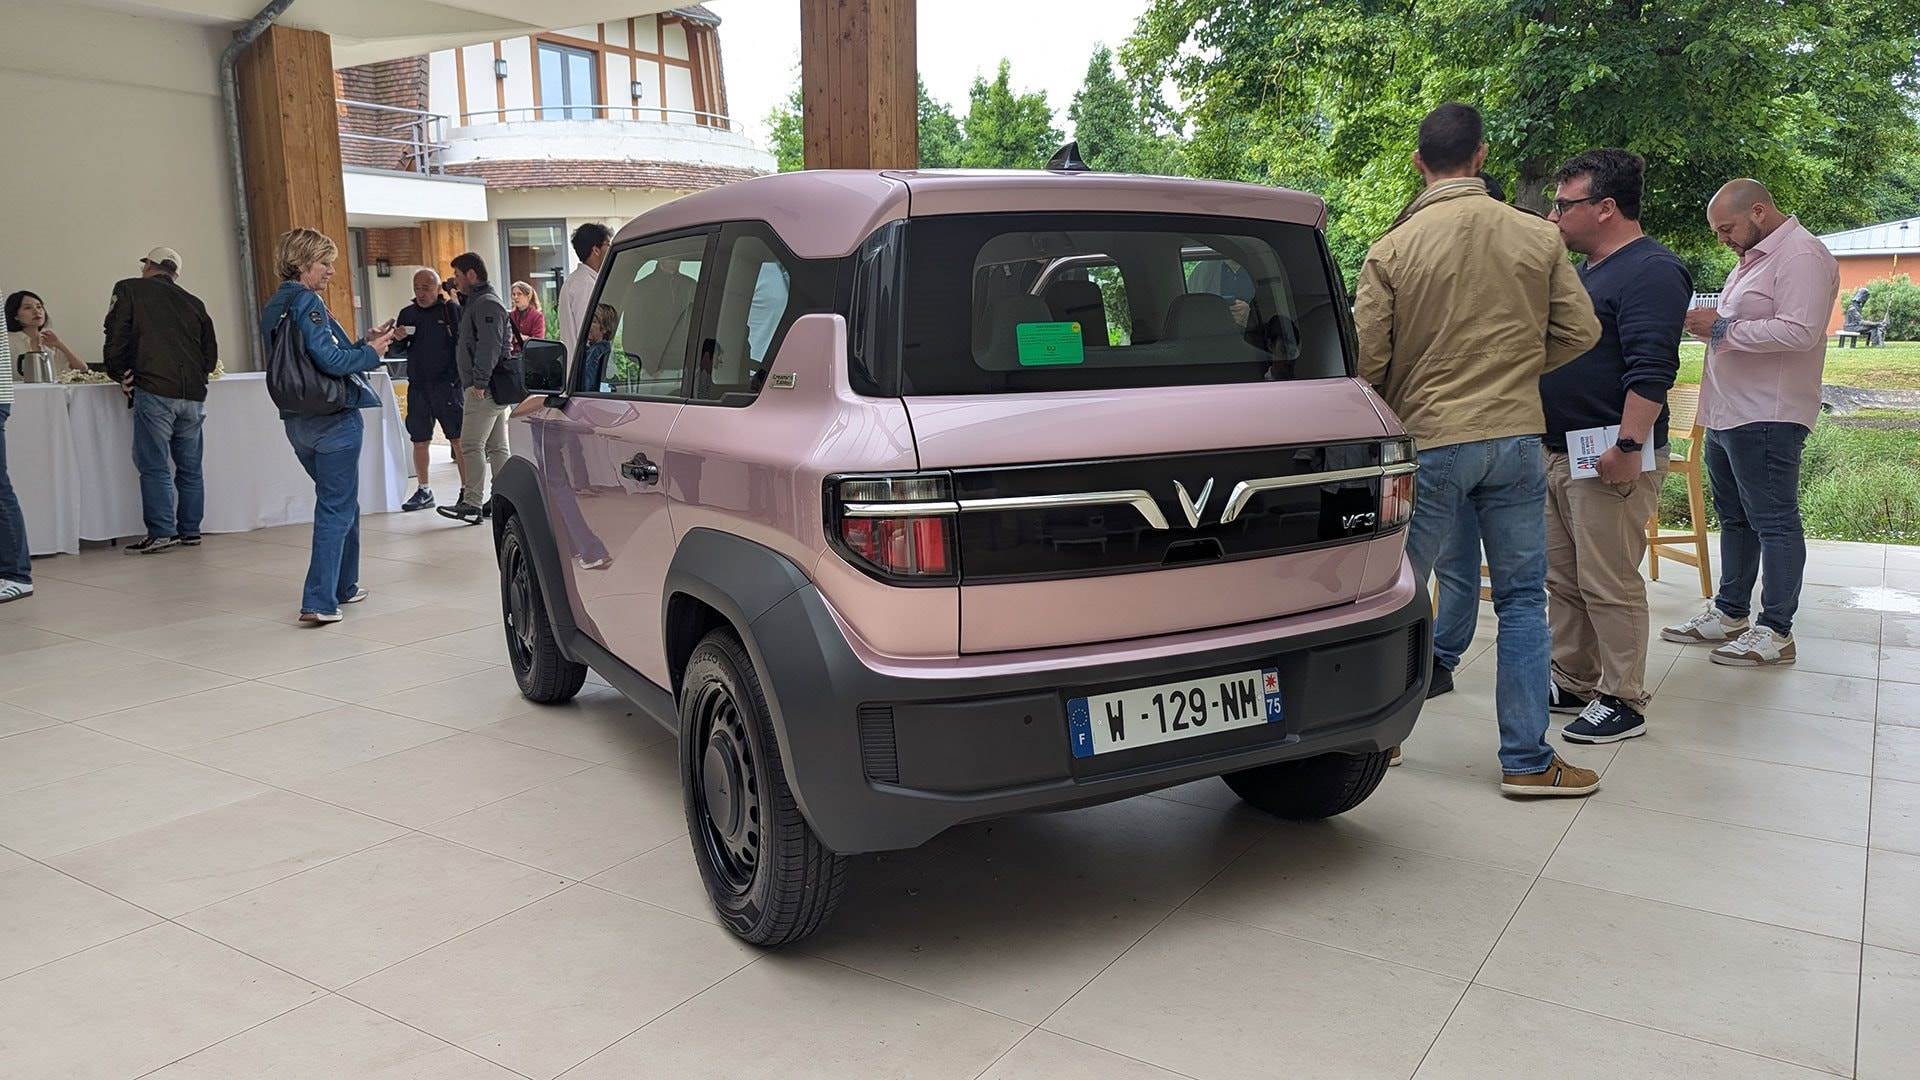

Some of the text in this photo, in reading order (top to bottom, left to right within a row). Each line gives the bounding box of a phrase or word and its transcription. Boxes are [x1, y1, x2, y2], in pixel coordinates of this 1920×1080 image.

[1342, 512, 1375, 529] VF3
[1266, 697, 1281, 714] 75
[1079, 733, 1086, 745] F
